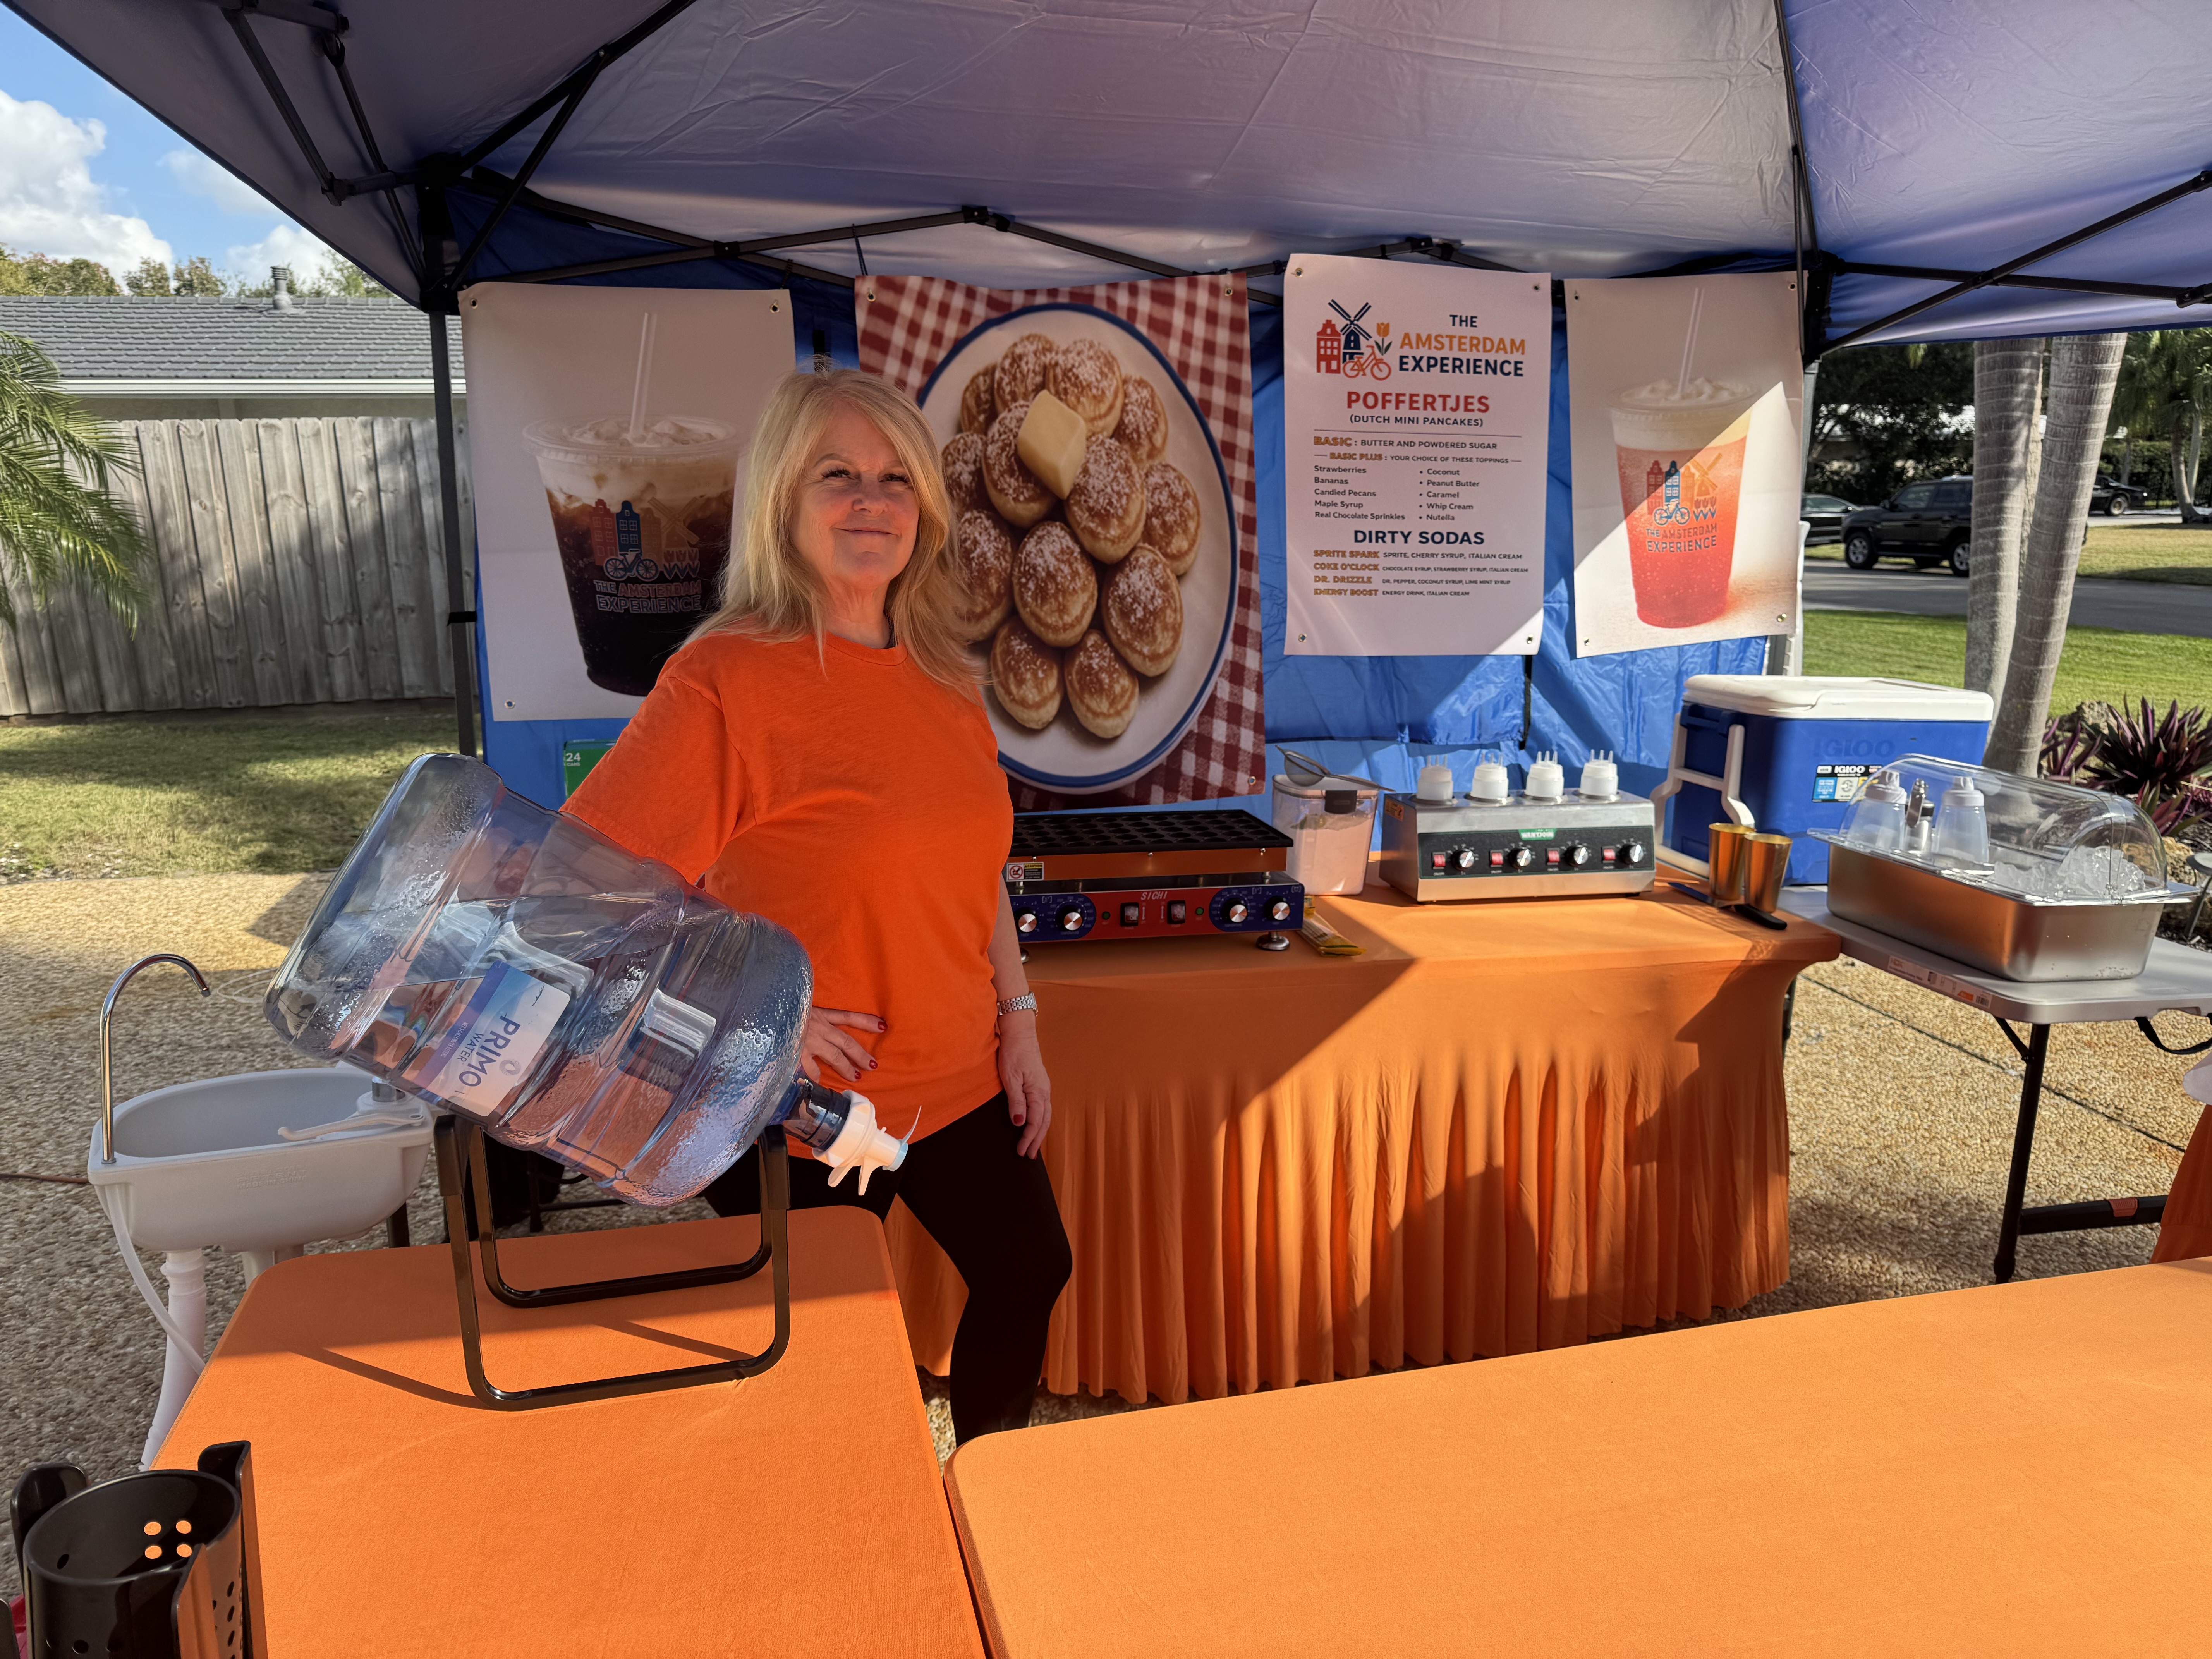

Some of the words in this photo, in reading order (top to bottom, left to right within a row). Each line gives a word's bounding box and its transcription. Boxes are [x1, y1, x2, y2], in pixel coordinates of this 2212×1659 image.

[1449, 314, 1478, 328] THE
[1400, 332, 1525, 355] AMSTERDAM
[1399, 355, 1523, 377] EXPERIENCE
[1347, 391, 1490, 413] POFFERTJES
[1350, 414, 1390, 424] (DUTCH
[1394, 416, 1419, 424] MINI
[1423, 417, 1483, 427] PANCAKES)
[1314, 436, 1352, 446] BASIC
[1314, 465, 1367, 473] Strawberries
[1354, 530, 1412, 544] DIRTY
[1418, 531, 1484, 545] SODAS
[1646, 528, 1660, 537] THE
[1661, 522, 1717, 539] AMSTERDAM
[1647, 535, 1717, 553] EXPERIENCE
[1340, 563, 1380, 571] O'CLOCK
[593, 580, 617, 594] THE
[618, 580, 702, 598] AMSTERDAM
[596, 594, 702, 613] EXPERIENCE
[566, 752, 581, 762] 24
[1834, 765, 1865, 774] IGLOO
[1141, 891, 1168, 900] SICHI
[457, 1033, 484, 1062] WATER
[459, 1013, 521, 1087] PRIMO
